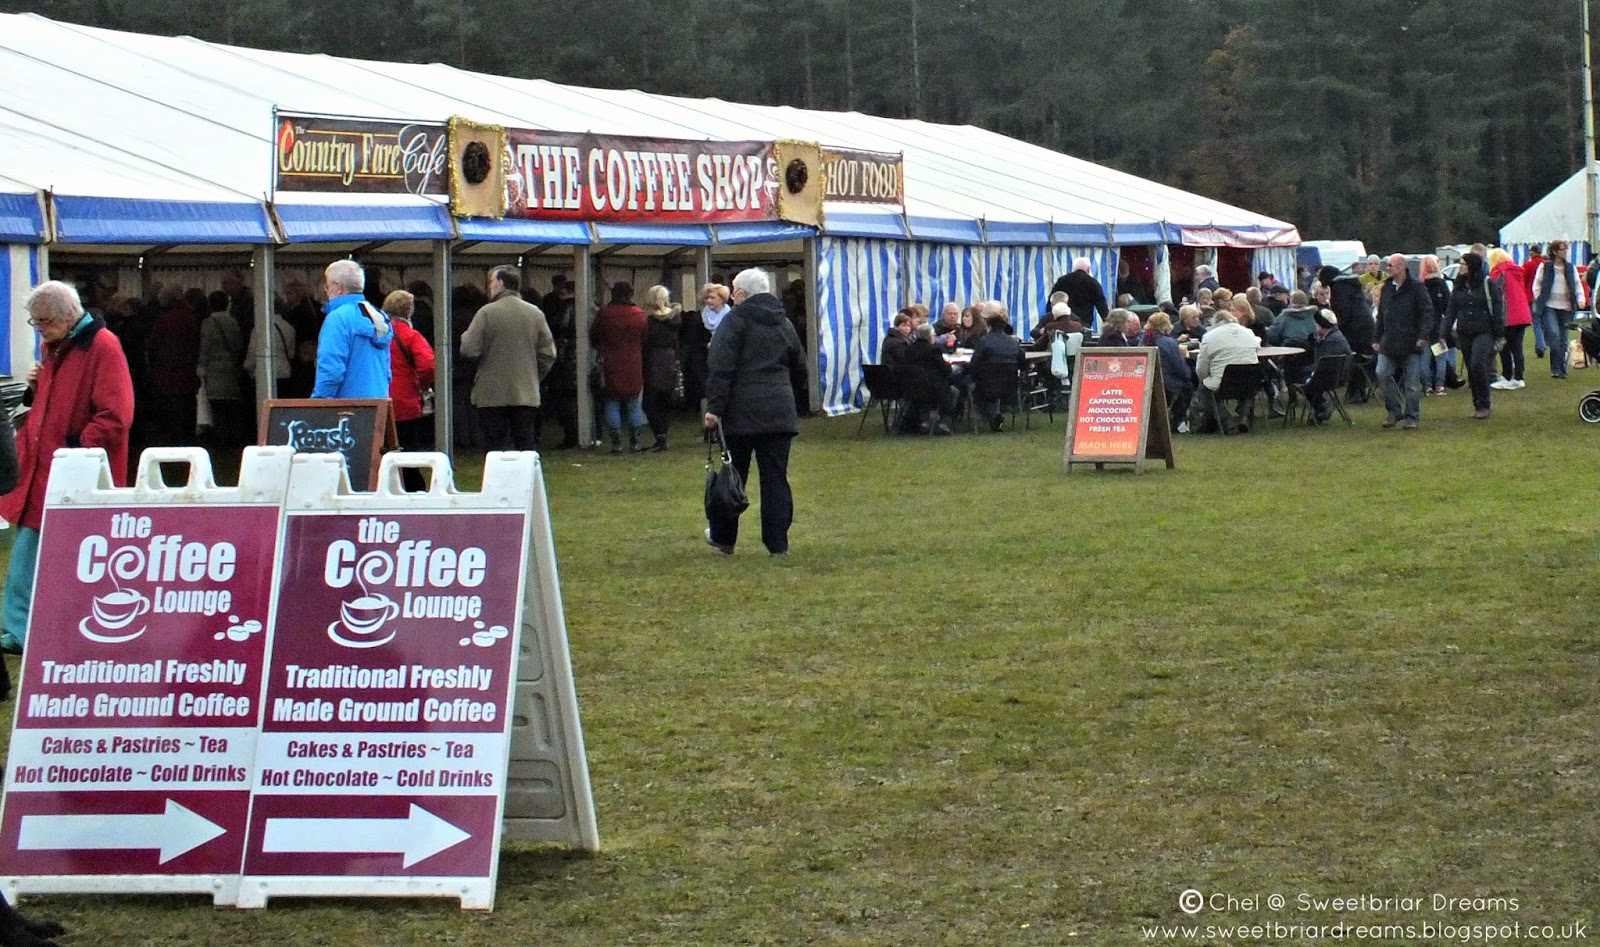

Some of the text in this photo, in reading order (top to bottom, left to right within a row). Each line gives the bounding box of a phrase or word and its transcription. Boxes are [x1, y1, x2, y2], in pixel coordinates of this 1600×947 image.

[279, 123, 448, 196] Country Fare Café
[516, 144, 764, 212] THE COFFEE SHOP
[825, 161, 861, 196] HOT
[1080, 441, 1133, 450] MADE HERE
[111, 512, 152, 539] the
[358, 517, 400, 543] the
[77, 534, 237, 584] Coffee
[324, 540, 487, 588] Coffee
[153, 586, 232, 616] Lounge
[402, 591, 482, 621] Lounge
[42, 659, 247, 685] Traditional Freshly
[285, 665, 493, 691] Traditional Freshly
[27, 692, 250, 718] Made Ground Coffee
[272, 697, 496, 722] Made Ground Coffee
[41, 736, 93, 755] Cakes
[96, 738, 108, 754] &
[111, 736, 181, 753] Pastries
[199, 736, 228, 753] Tea
[287, 740, 339, 758] Cakes
[341, 741, 353, 758] &
[356, 740, 427, 758] Pastries
[445, 741, 475, 759] Tea
[14, 765, 44, 783] Hot
[46, 765, 133, 783] Chocolate
[150, 764, 188, 782] Cold
[192, 764, 247, 782] Drinks
[261, 769, 290, 787] Hot
[292, 768, 379, 787] Chocolate
[396, 769, 435, 787] Cold
[438, 769, 494, 787] Drinks
